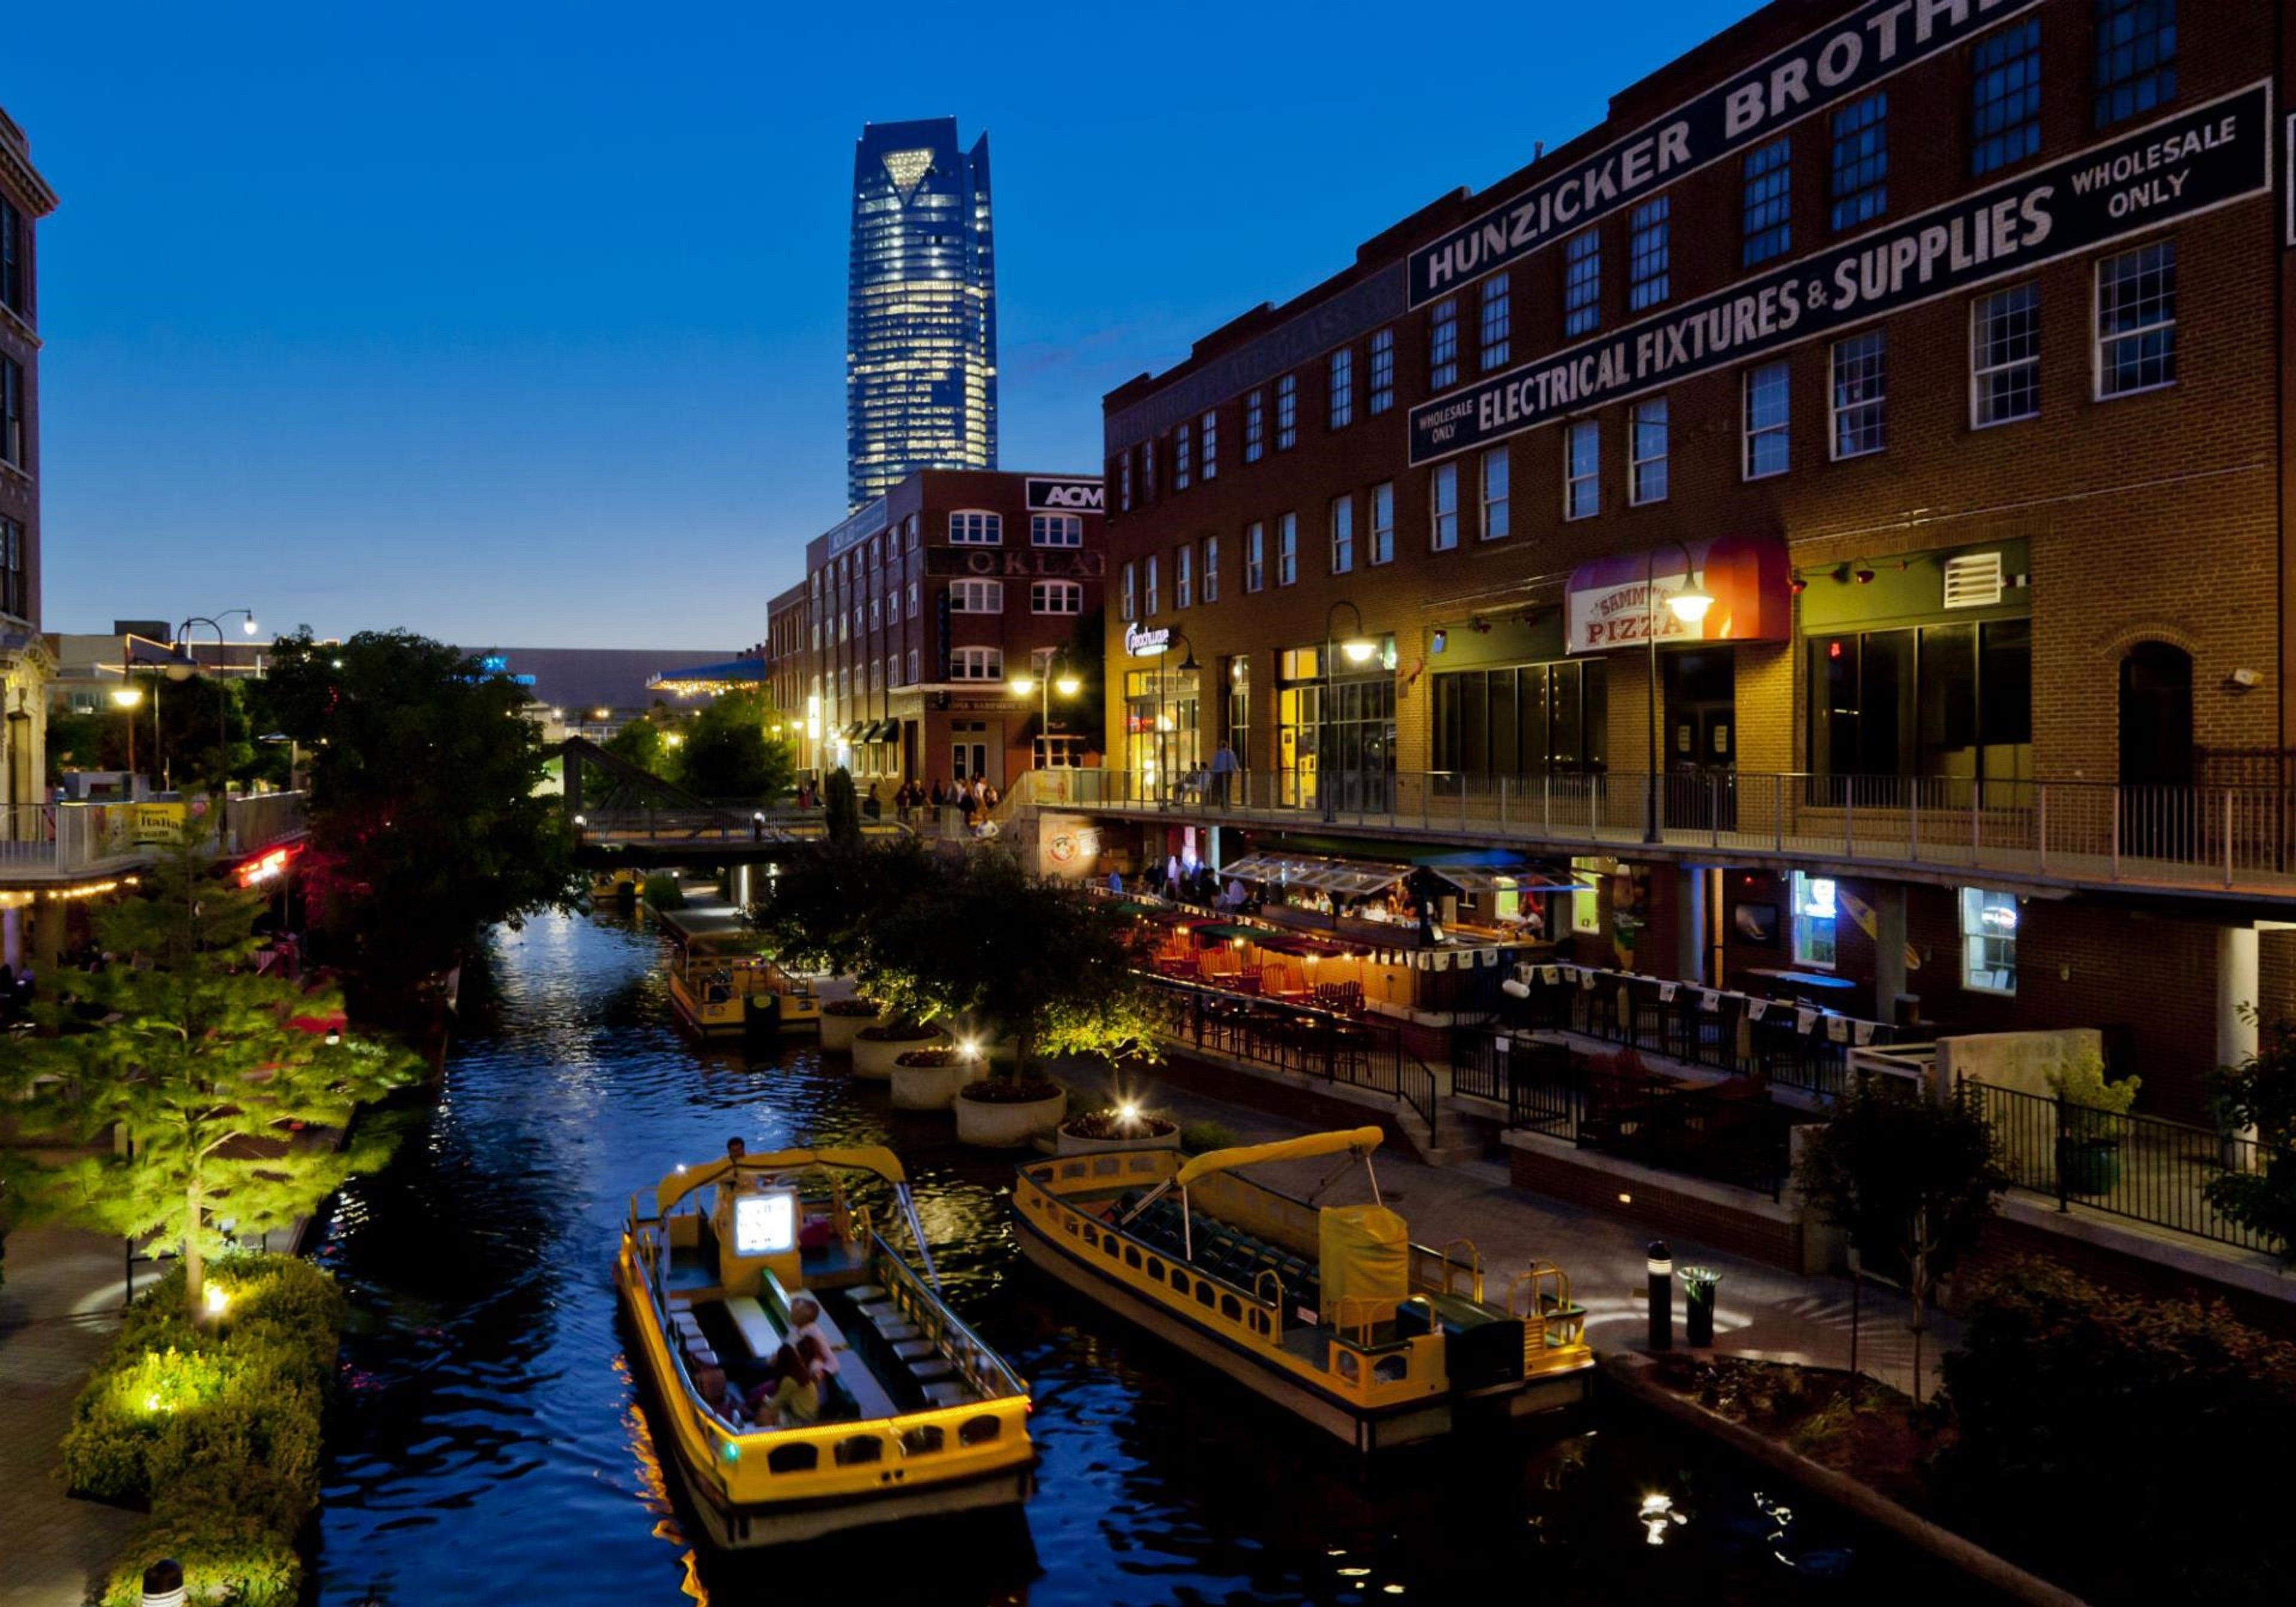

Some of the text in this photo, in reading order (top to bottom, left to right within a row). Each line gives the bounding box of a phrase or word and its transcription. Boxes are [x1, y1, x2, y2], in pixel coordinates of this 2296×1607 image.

[2071, 115, 2236, 196] WHOLESALE
[1427, 120, 1692, 289] HUNZICKER
[2107, 168, 2191, 219] ONLY
[1478, 343, 1631, 432] ELECTRICAL
[1636, 279, 1800, 378] FIXTURES
[1807, 281, 1828, 310] &
[1832, 185, 2056, 311] SUPPLIES
[1418, 399, 1473, 430] WHOLESALE
[1431, 422, 1457, 444] ONLY
[1588, 614, 1684, 643] PIZZA
